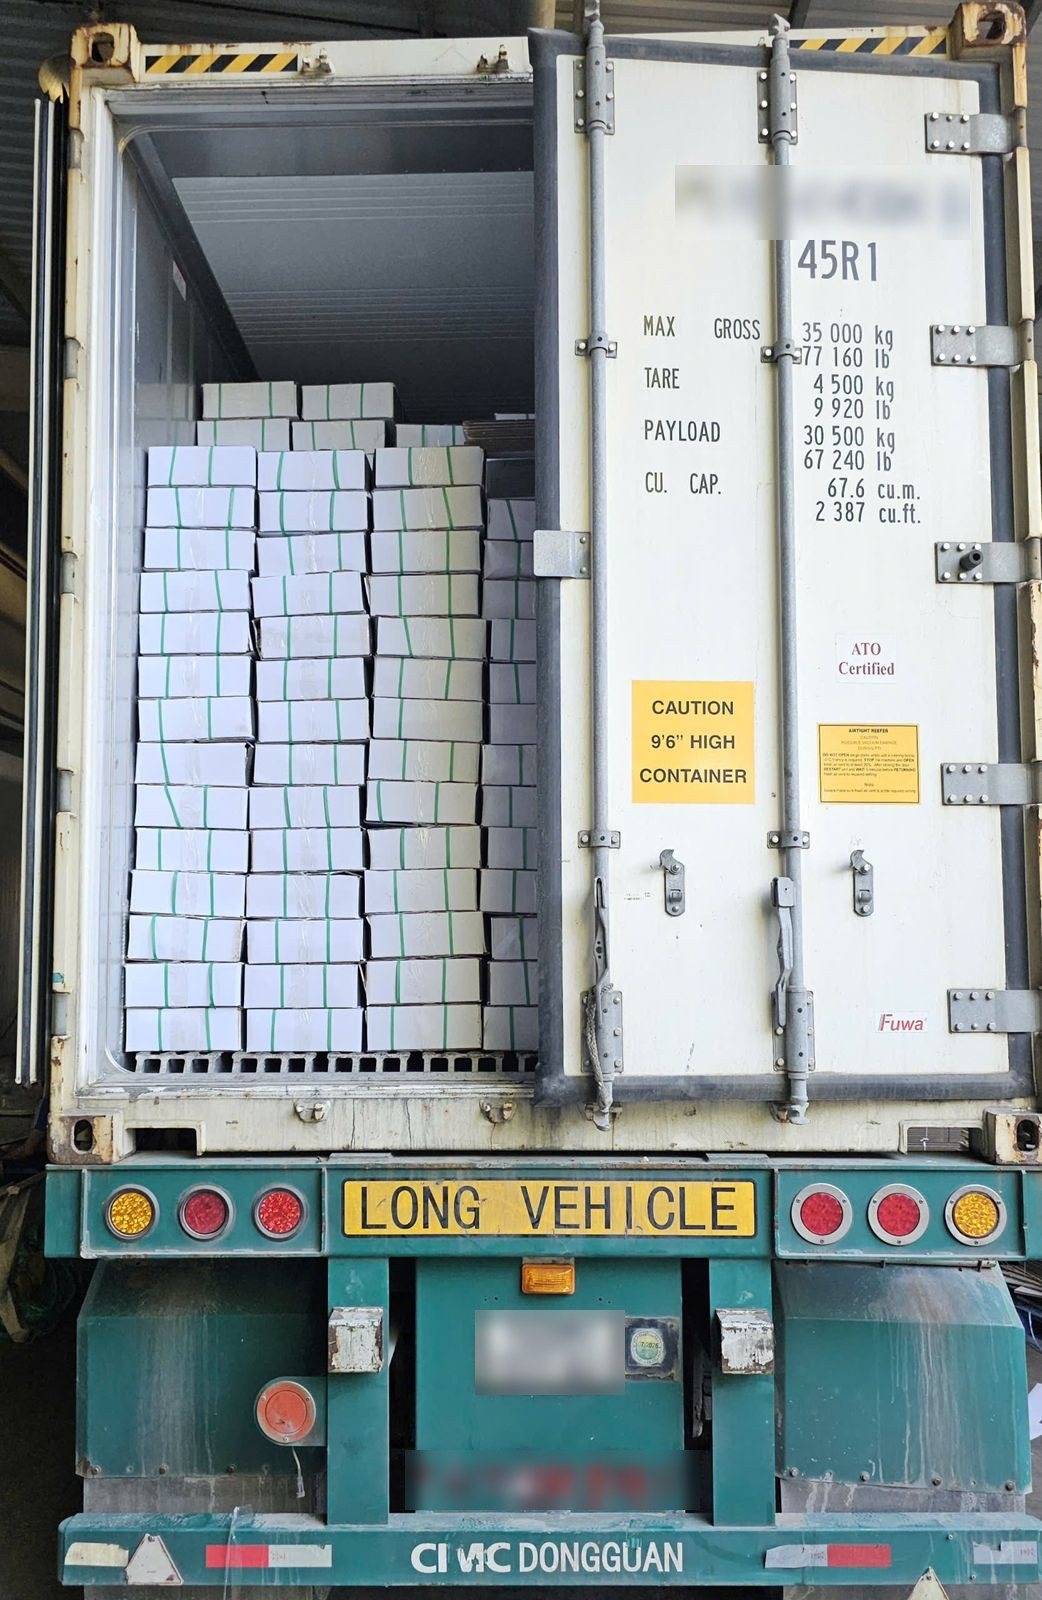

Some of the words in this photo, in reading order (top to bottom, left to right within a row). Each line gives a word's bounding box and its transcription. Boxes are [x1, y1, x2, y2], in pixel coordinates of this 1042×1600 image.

[798, 240, 877, 281] 45R1
[644, 315, 676, 337] MAX
[714, 318, 761, 340] GROSS
[802, 322, 823, 343] 35
[831, 323, 863, 344] 000
[875, 325, 894, 348] kg
[802, 346, 823, 366] 77
[833, 347, 863, 368] 160
[875, 349, 891, 369] lb
[644, 367, 681, 390] TARE
[813, 374, 824, 395] 4
[831, 374, 864, 396] 500
[876, 376, 895, 401] kg
[814, 397, 824, 418] 9
[831, 398, 864, 419] 920
[876, 401, 892, 421] lb
[644, 420, 721, 442] PAYLOAD
[803, 425, 825, 446] 30
[832, 426, 865, 447] 500
[876, 427, 895, 452] kg
[803, 449, 825, 470] 67
[832, 449, 865, 471] 240
[877, 452, 893, 472] lb
[645, 472, 668, 494] CU.
[689, 472, 722, 495] CAP.
[827, 478, 865, 499] 67.6
[878, 484, 921, 500] cu.m.
[815, 501, 825, 522] 2
[833, 501, 865, 523] 387
[879, 502, 921, 524] cu.ft.
[851, 642, 882, 656] ATO
[838, 661, 895, 676] Certified
[651, 700, 734, 716] CAUTION
[690, 734, 735, 750] HIGH
[640, 768, 747, 784] CONTAINER
[879, 1013, 924, 1031] Fuwa
[360, 1185, 481, 1230] LONG
[520, 1186, 738, 1231] VEHICLE
[519, 1541, 684, 1573] DONGGUAN
